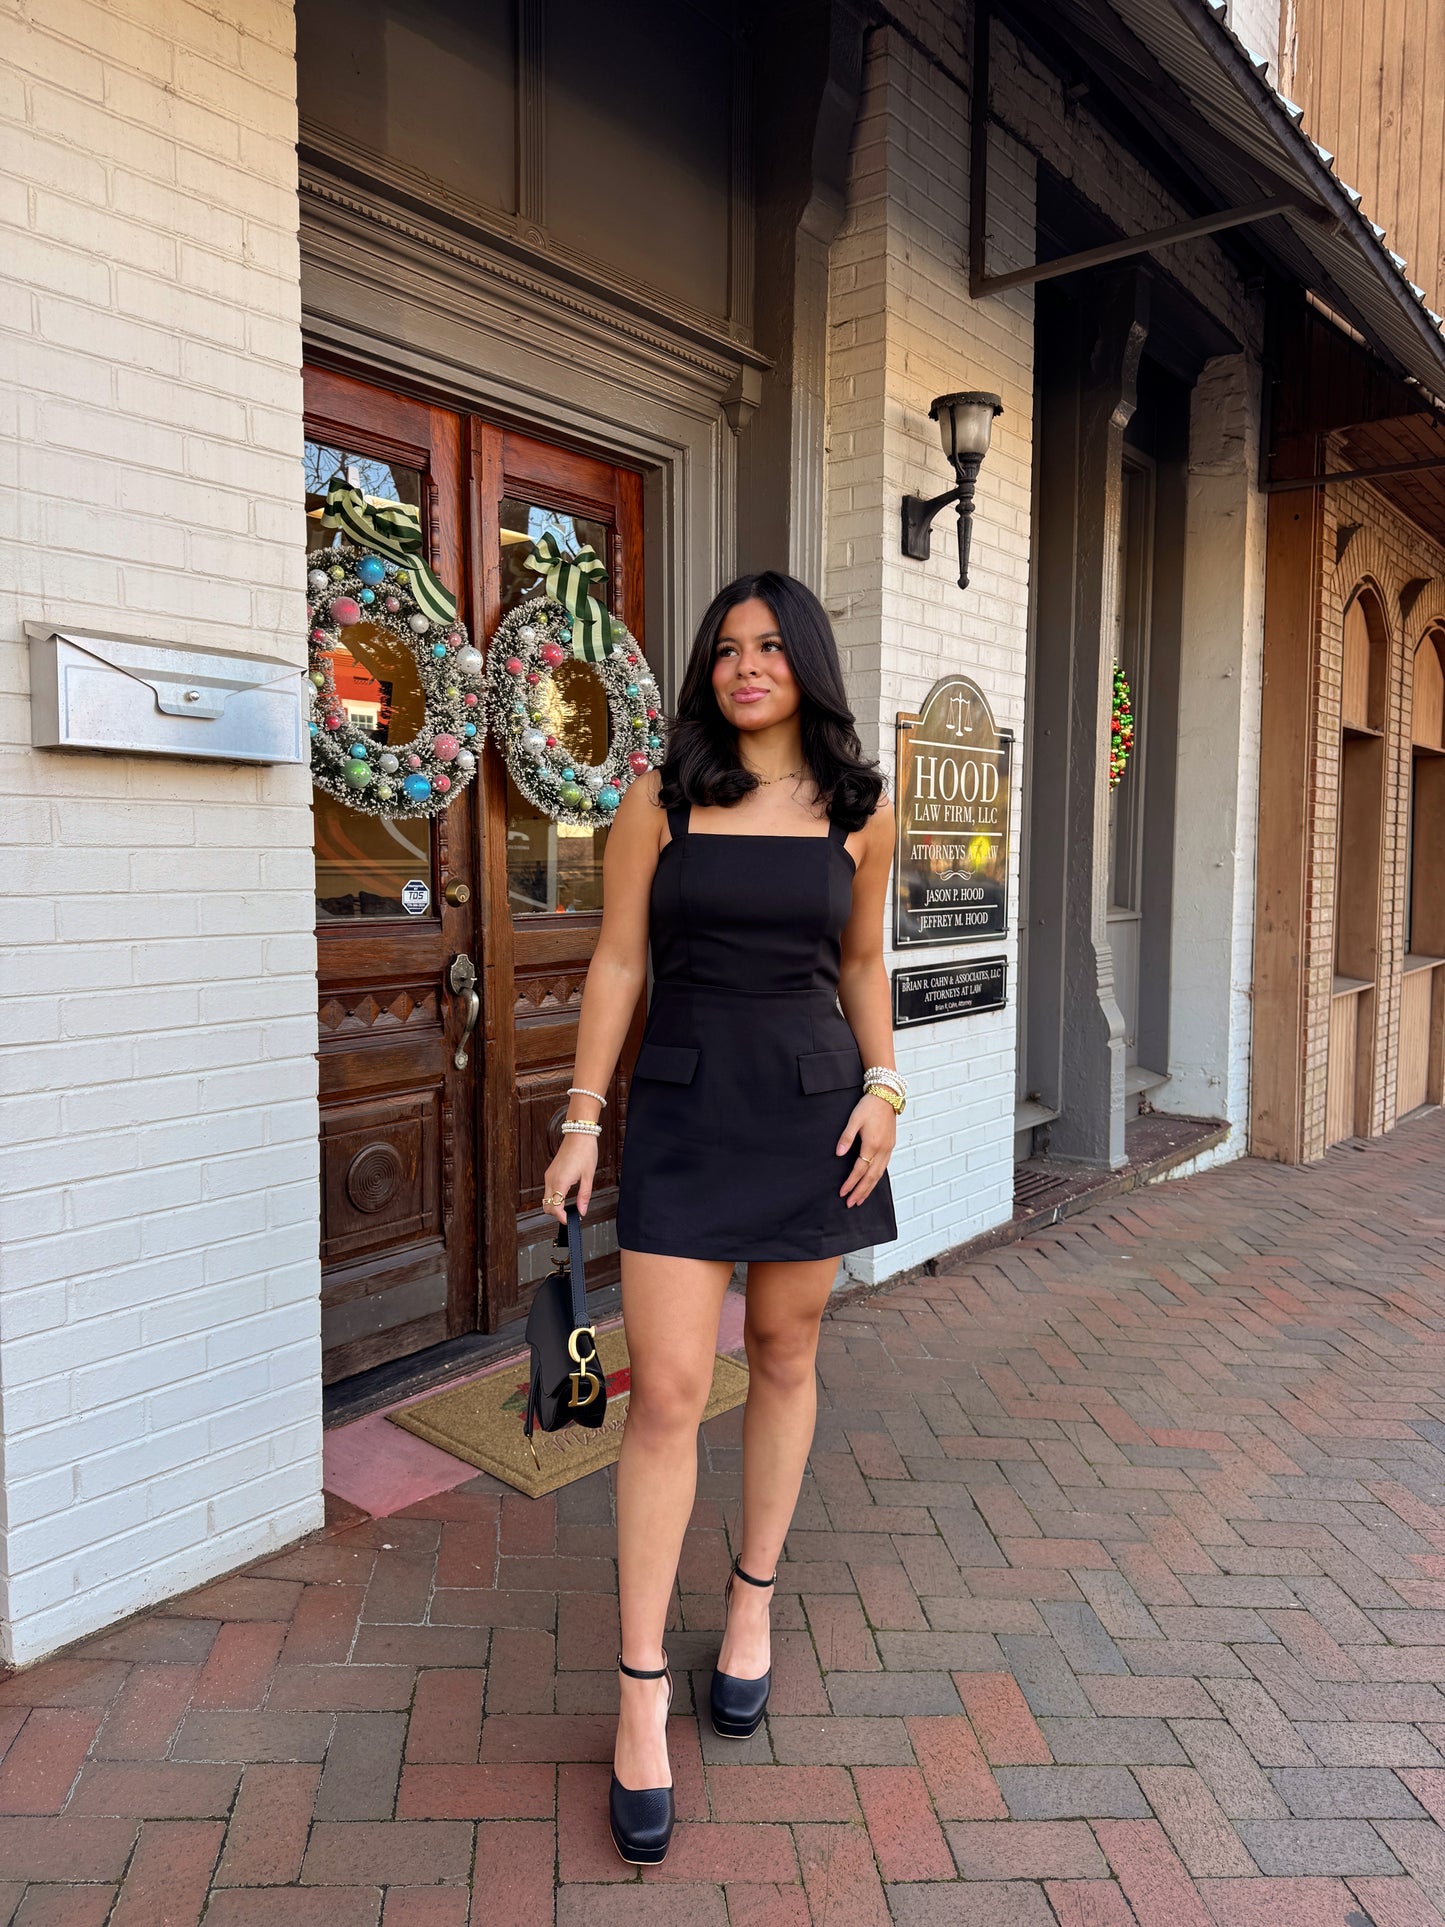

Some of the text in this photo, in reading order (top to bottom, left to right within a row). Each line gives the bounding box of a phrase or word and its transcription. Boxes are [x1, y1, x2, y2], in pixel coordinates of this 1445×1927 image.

[914, 755, 999, 803] HOOD
[914, 803, 998, 826] LAW FIRM, LLC
[910, 844, 966, 860] ATTORNEYS
[980, 844, 999, 860] AW
[924, 887, 985, 906] JASON P. HOOD
[918, 911, 989, 933] JEFFREY M. HOOD
[902, 979, 923, 992] BRIAN
[930, 975, 949, 988] CAHN
[949, 975, 954, 985] &
[954, 969, 990, 983] ASSOCIATES,
[990, 968, 1002, 978] LLC
[924, 984, 982, 1002] ATTORNEYS AT LAW
